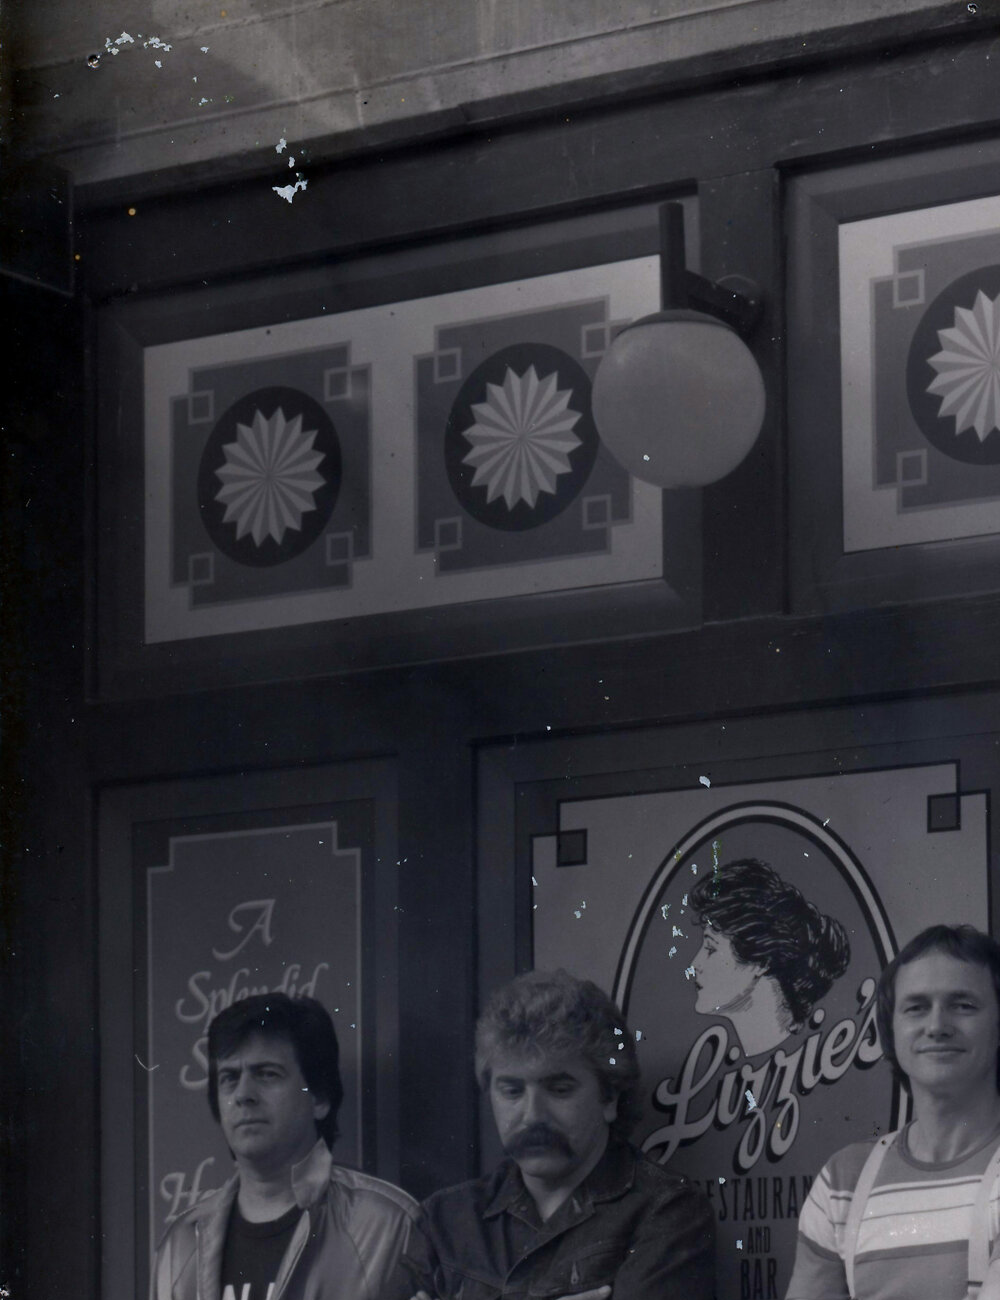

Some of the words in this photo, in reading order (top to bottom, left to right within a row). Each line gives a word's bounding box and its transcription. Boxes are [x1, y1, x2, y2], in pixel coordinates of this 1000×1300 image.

[212, 898, 277, 962] A
[174, 962, 330, 1034] Spldid
[641, 977, 885, 1171] Lizzie's
[746, 1226, 771, 1255] AND
[740, 1257, 778, 1300] BAR
